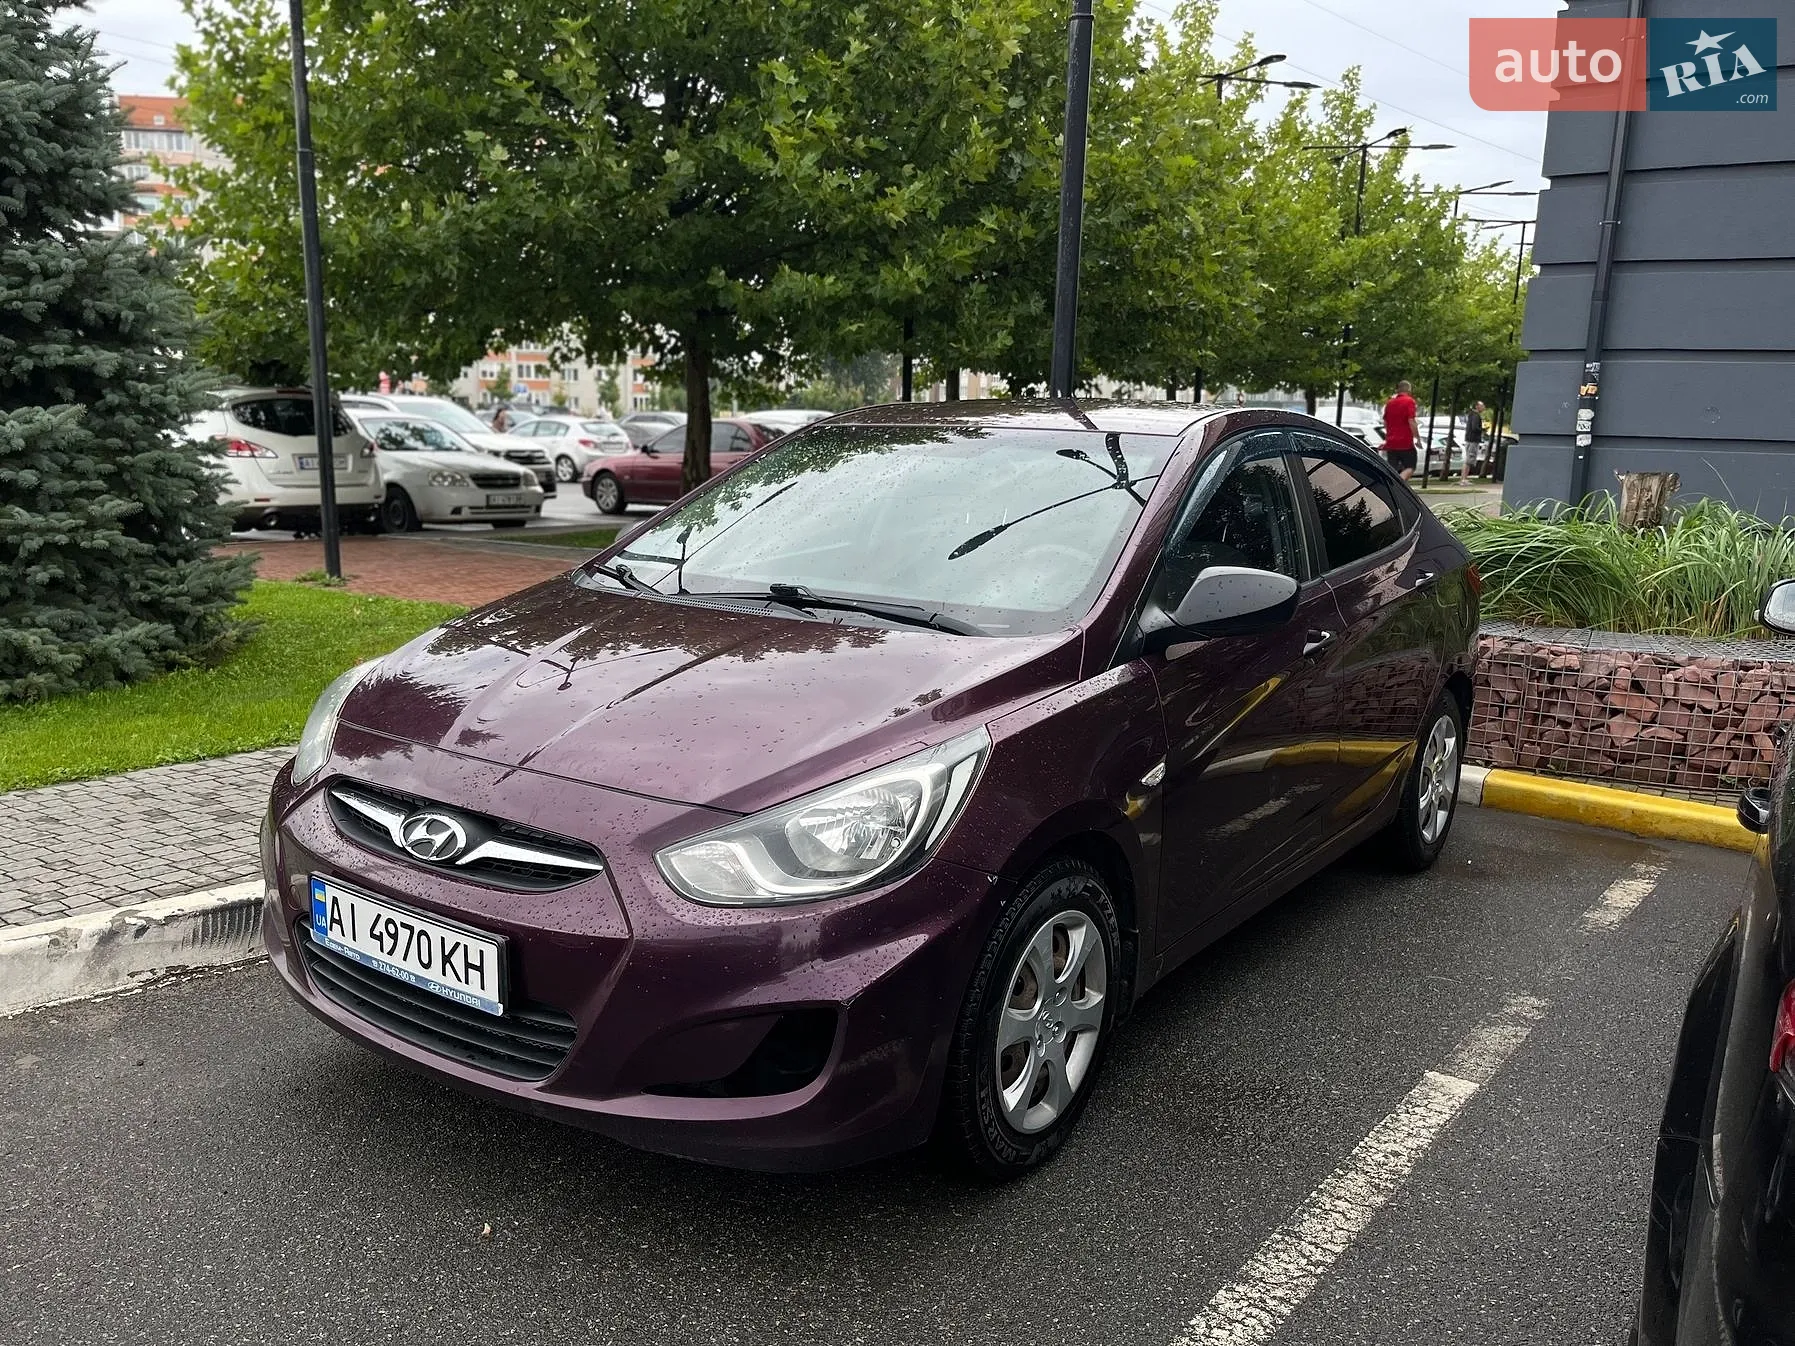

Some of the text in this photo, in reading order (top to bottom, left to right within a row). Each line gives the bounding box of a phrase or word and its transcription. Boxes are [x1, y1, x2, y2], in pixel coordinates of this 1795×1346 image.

[315, 914, 327, 928] UA
[369, 913, 432, 970] 4970
[440, 934, 485, 990] KH
[441, 986, 481, 1007] HYUNDAI
